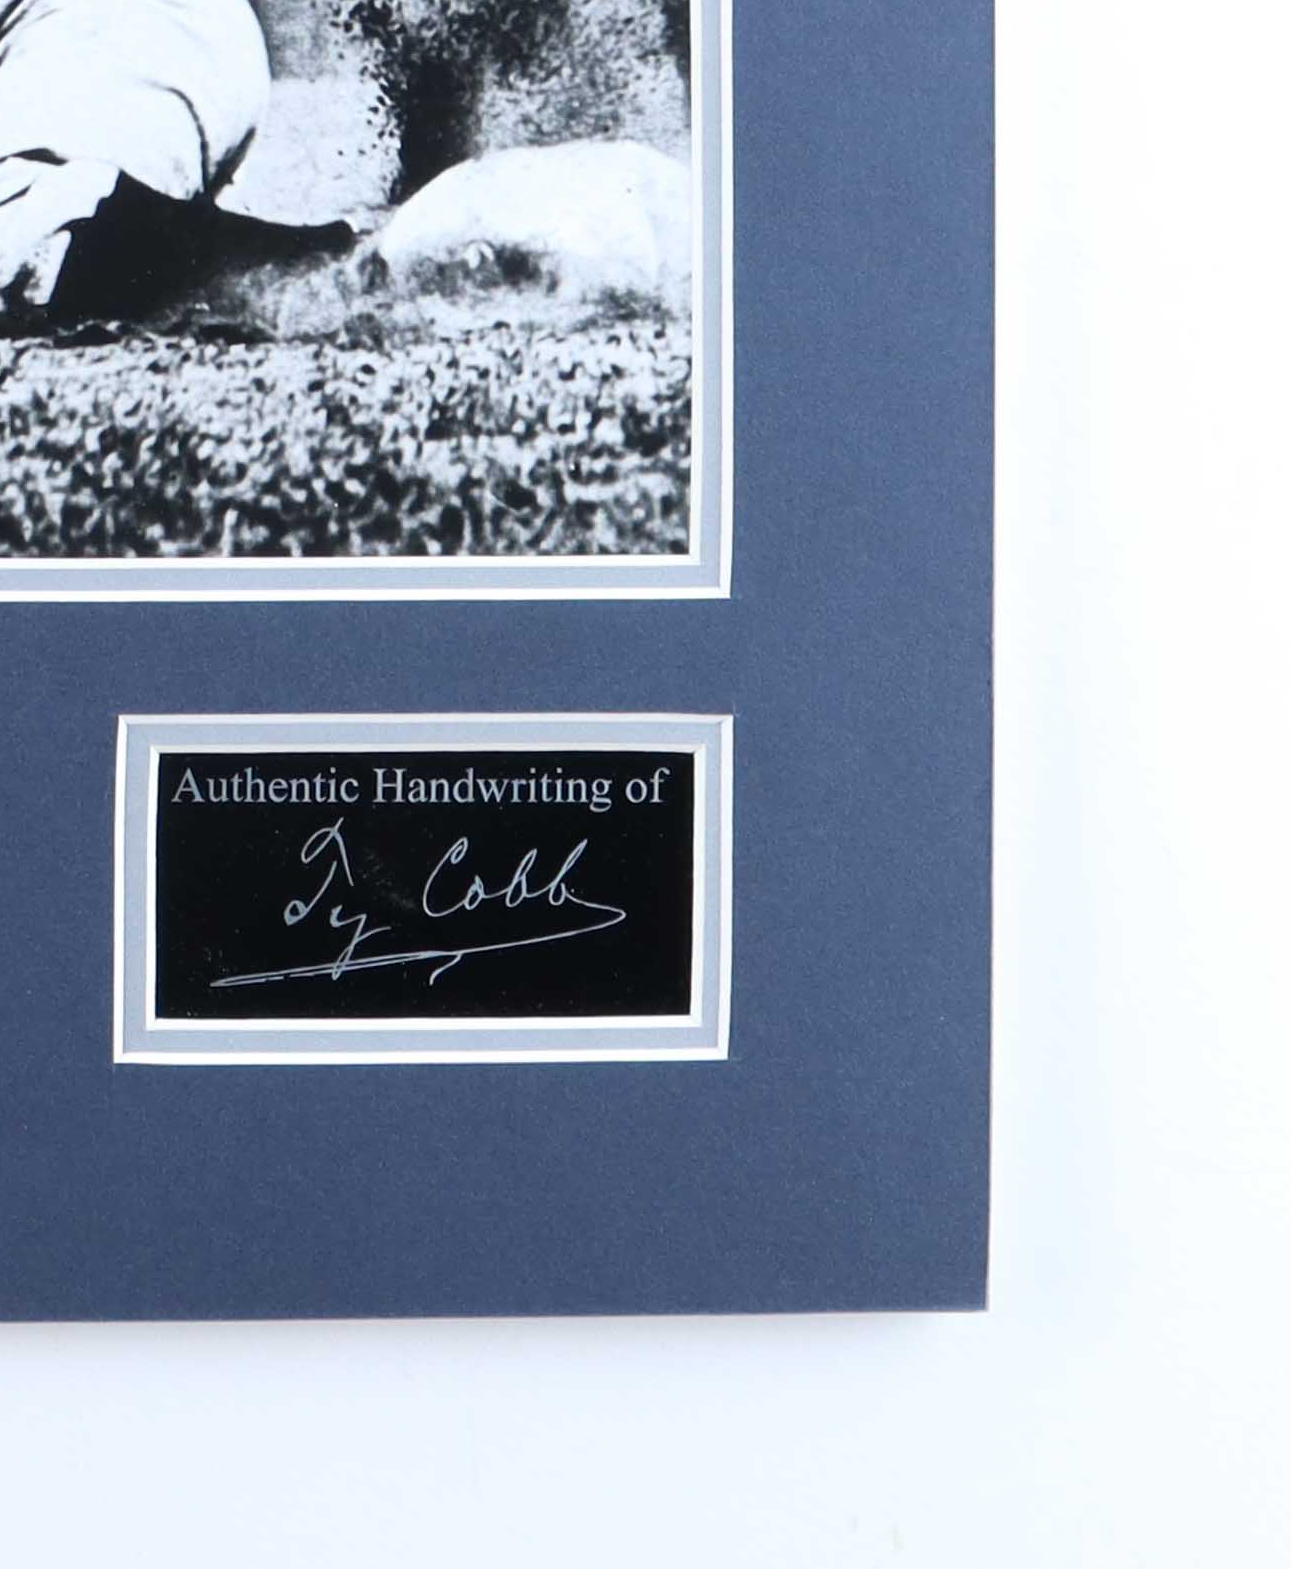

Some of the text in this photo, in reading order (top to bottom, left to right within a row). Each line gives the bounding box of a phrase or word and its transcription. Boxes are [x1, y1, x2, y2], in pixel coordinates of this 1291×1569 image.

[171, 766, 671, 813] Authentic Handwriting of
[284, 817, 626, 981] Ty Cobb
